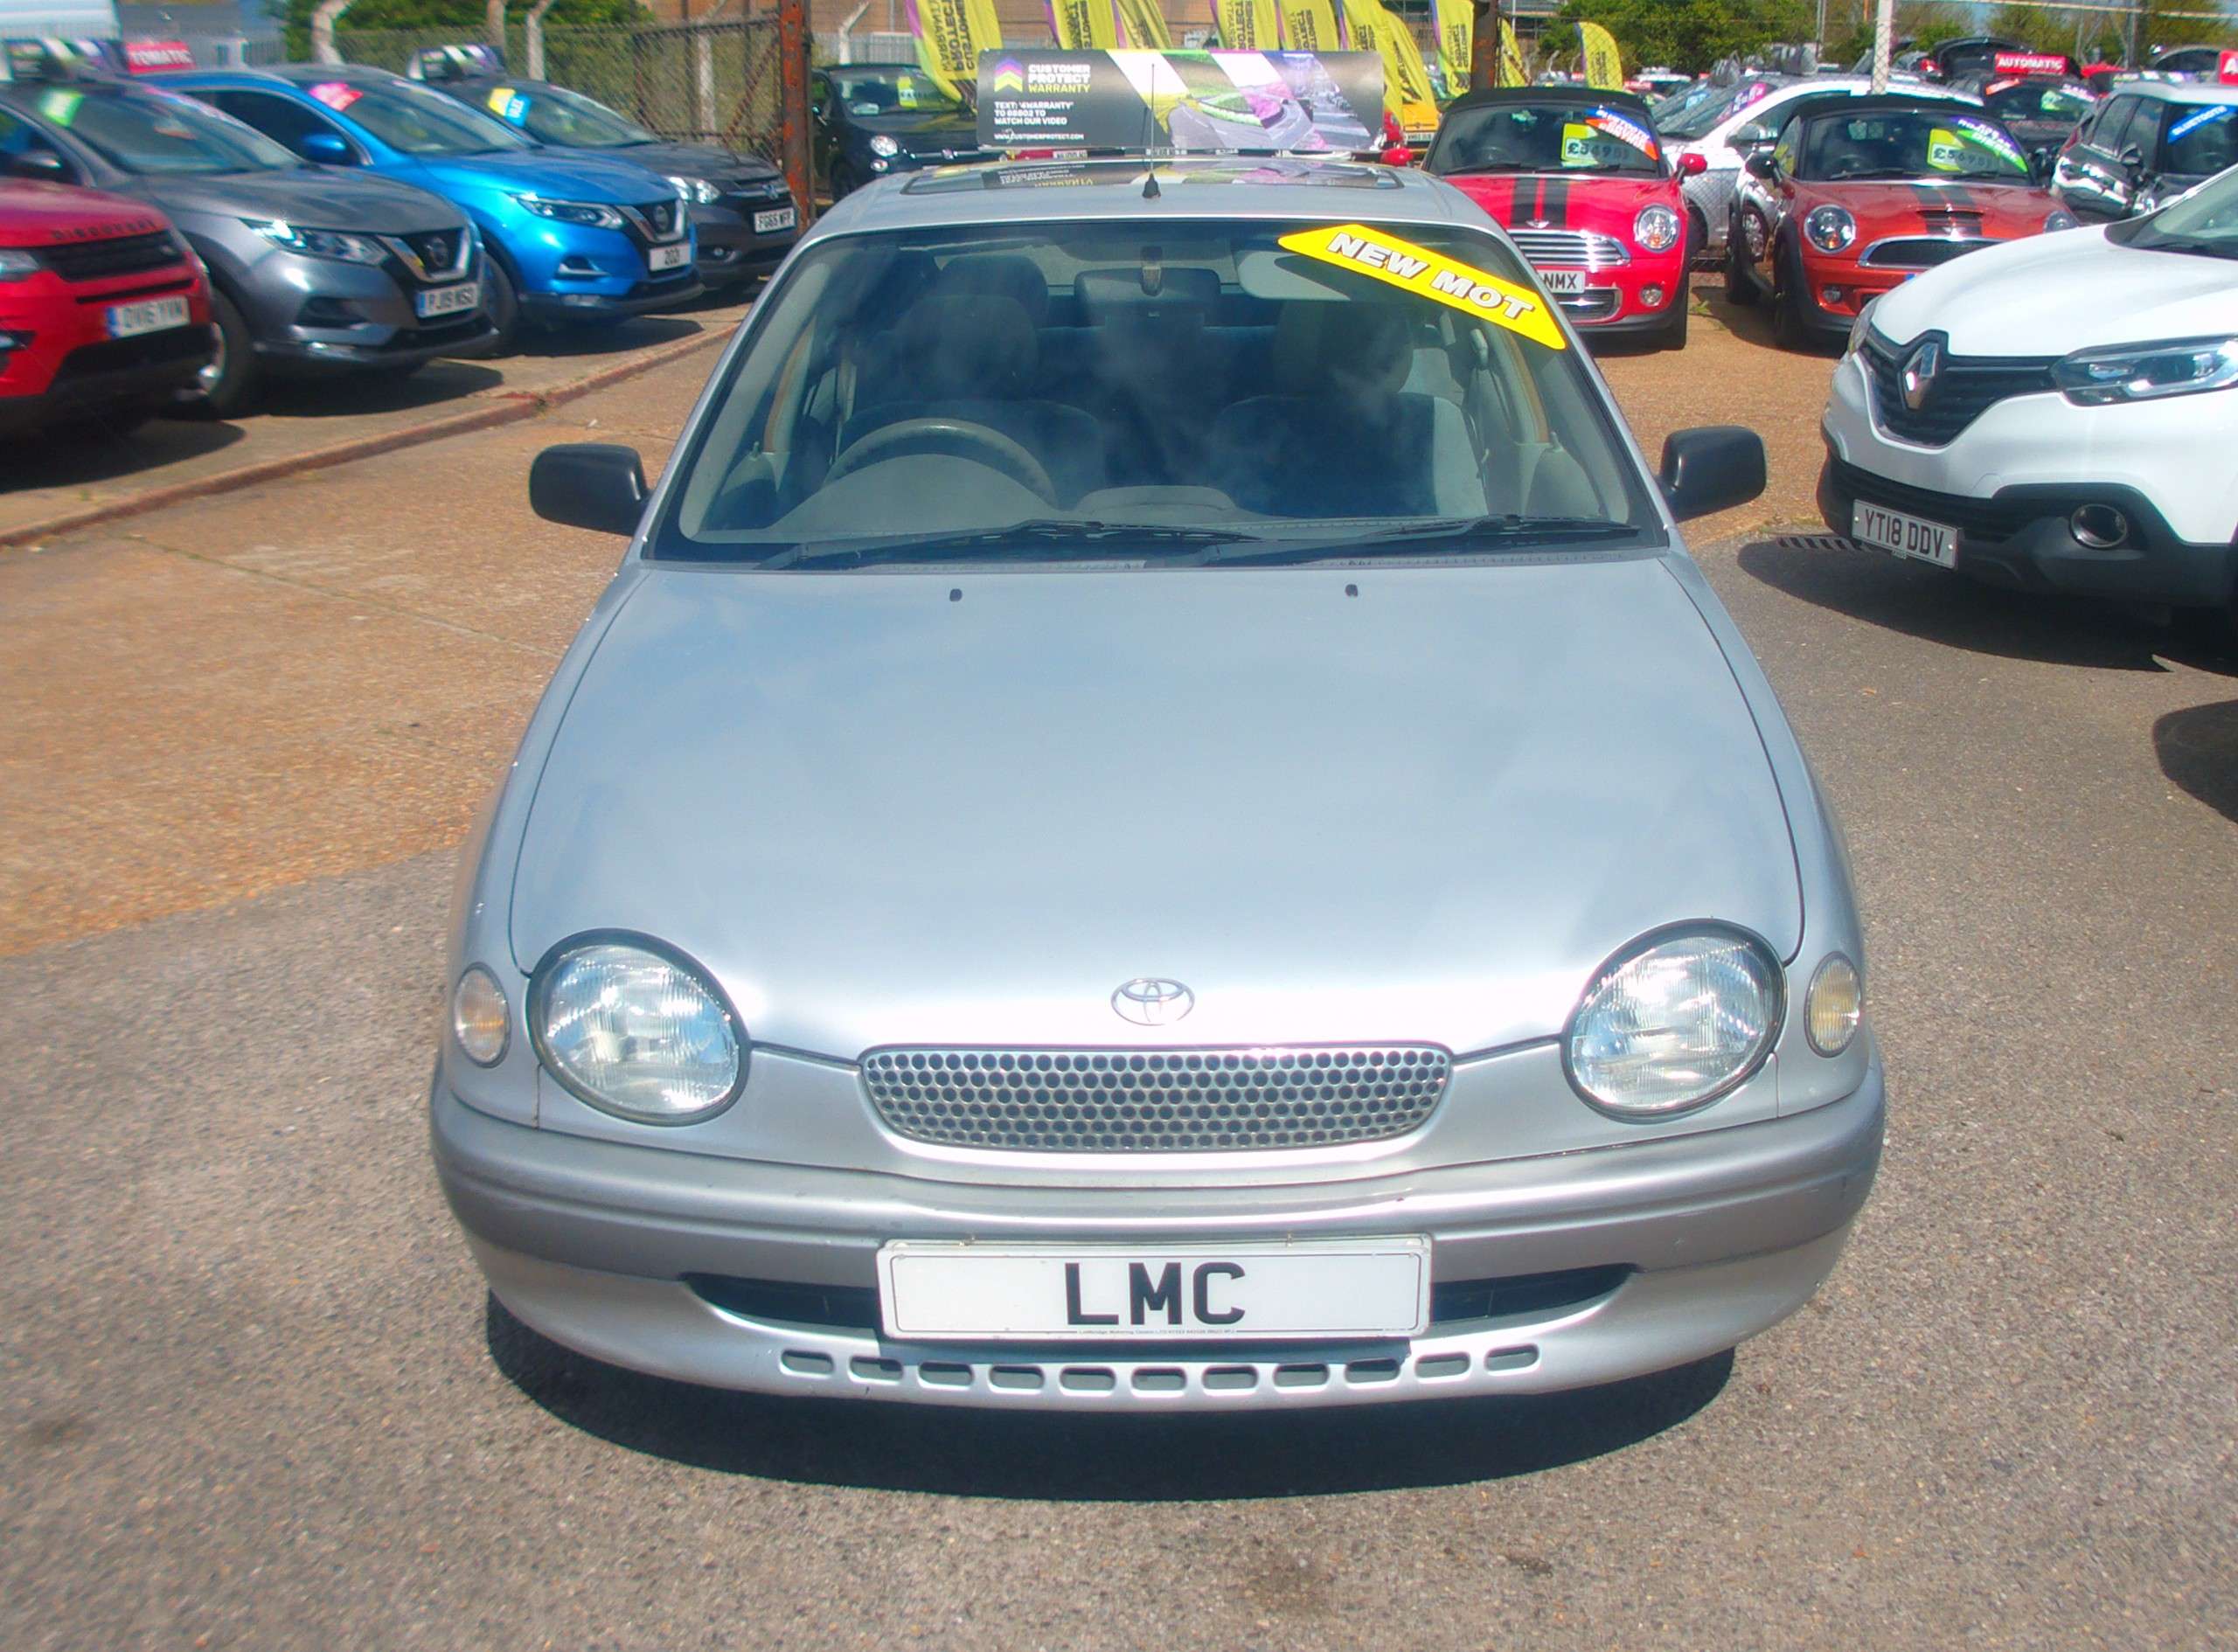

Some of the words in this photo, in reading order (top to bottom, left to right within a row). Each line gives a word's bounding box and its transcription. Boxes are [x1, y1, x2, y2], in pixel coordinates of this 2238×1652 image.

[1028, 64, 1090, 73] CUSTOMER
[1998, 56, 2063, 70] AUTOMATIC
[1028, 73, 1090, 83] PROTECT
[1028, 84, 1090, 93] WARRANTY
[1327, 232, 1430, 279] NEW
[1431, 269, 1535, 320] MOT
[1543, 273, 1578, 289] NMX
[1866, 509, 1901, 545] YT18
[1907, 522, 1944, 558] DDV
[1065, 1261, 1246, 1325] LMC
